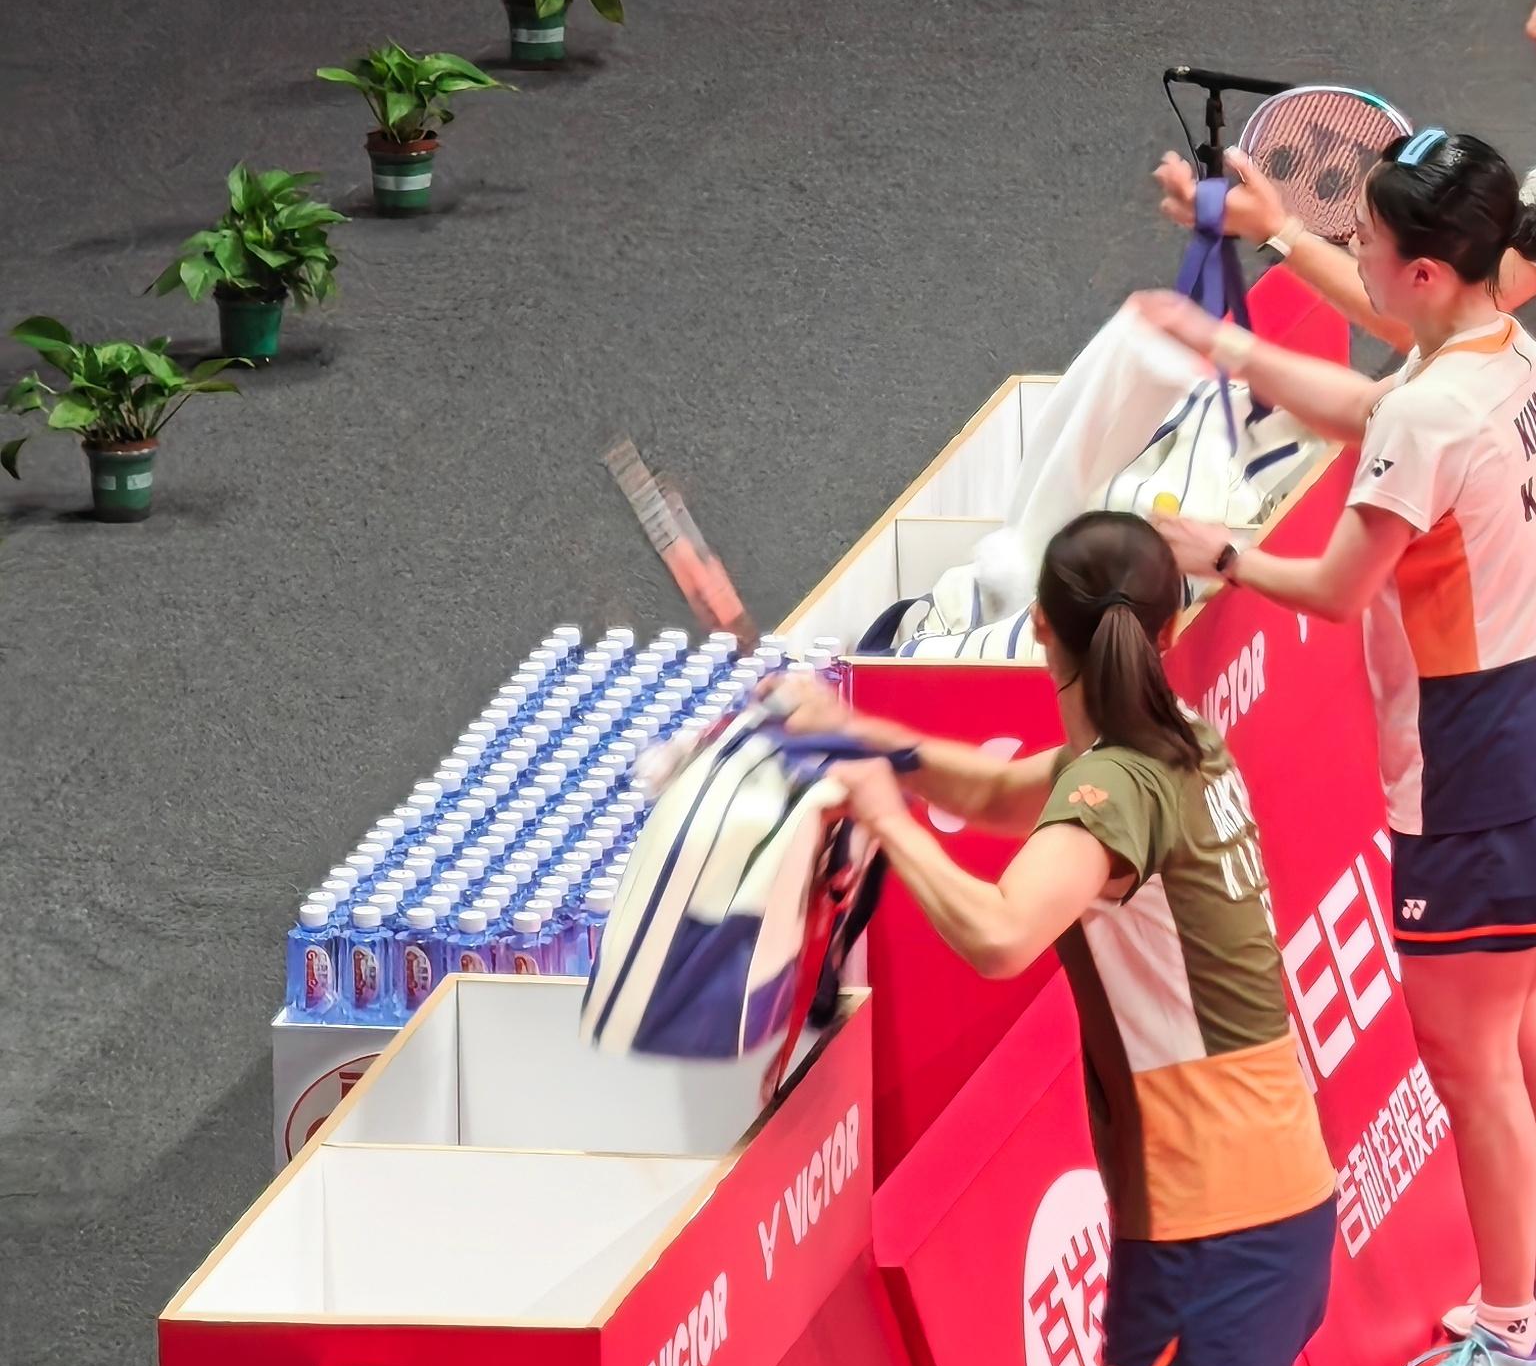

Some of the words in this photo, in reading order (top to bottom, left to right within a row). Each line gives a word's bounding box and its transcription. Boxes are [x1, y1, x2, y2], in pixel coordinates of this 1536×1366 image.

[1201, 630, 1265, 740] ICTOR
[783, 1104, 859, 1246] VICTOR
[1336, 1055, 1453, 1260] 吉利控股集
